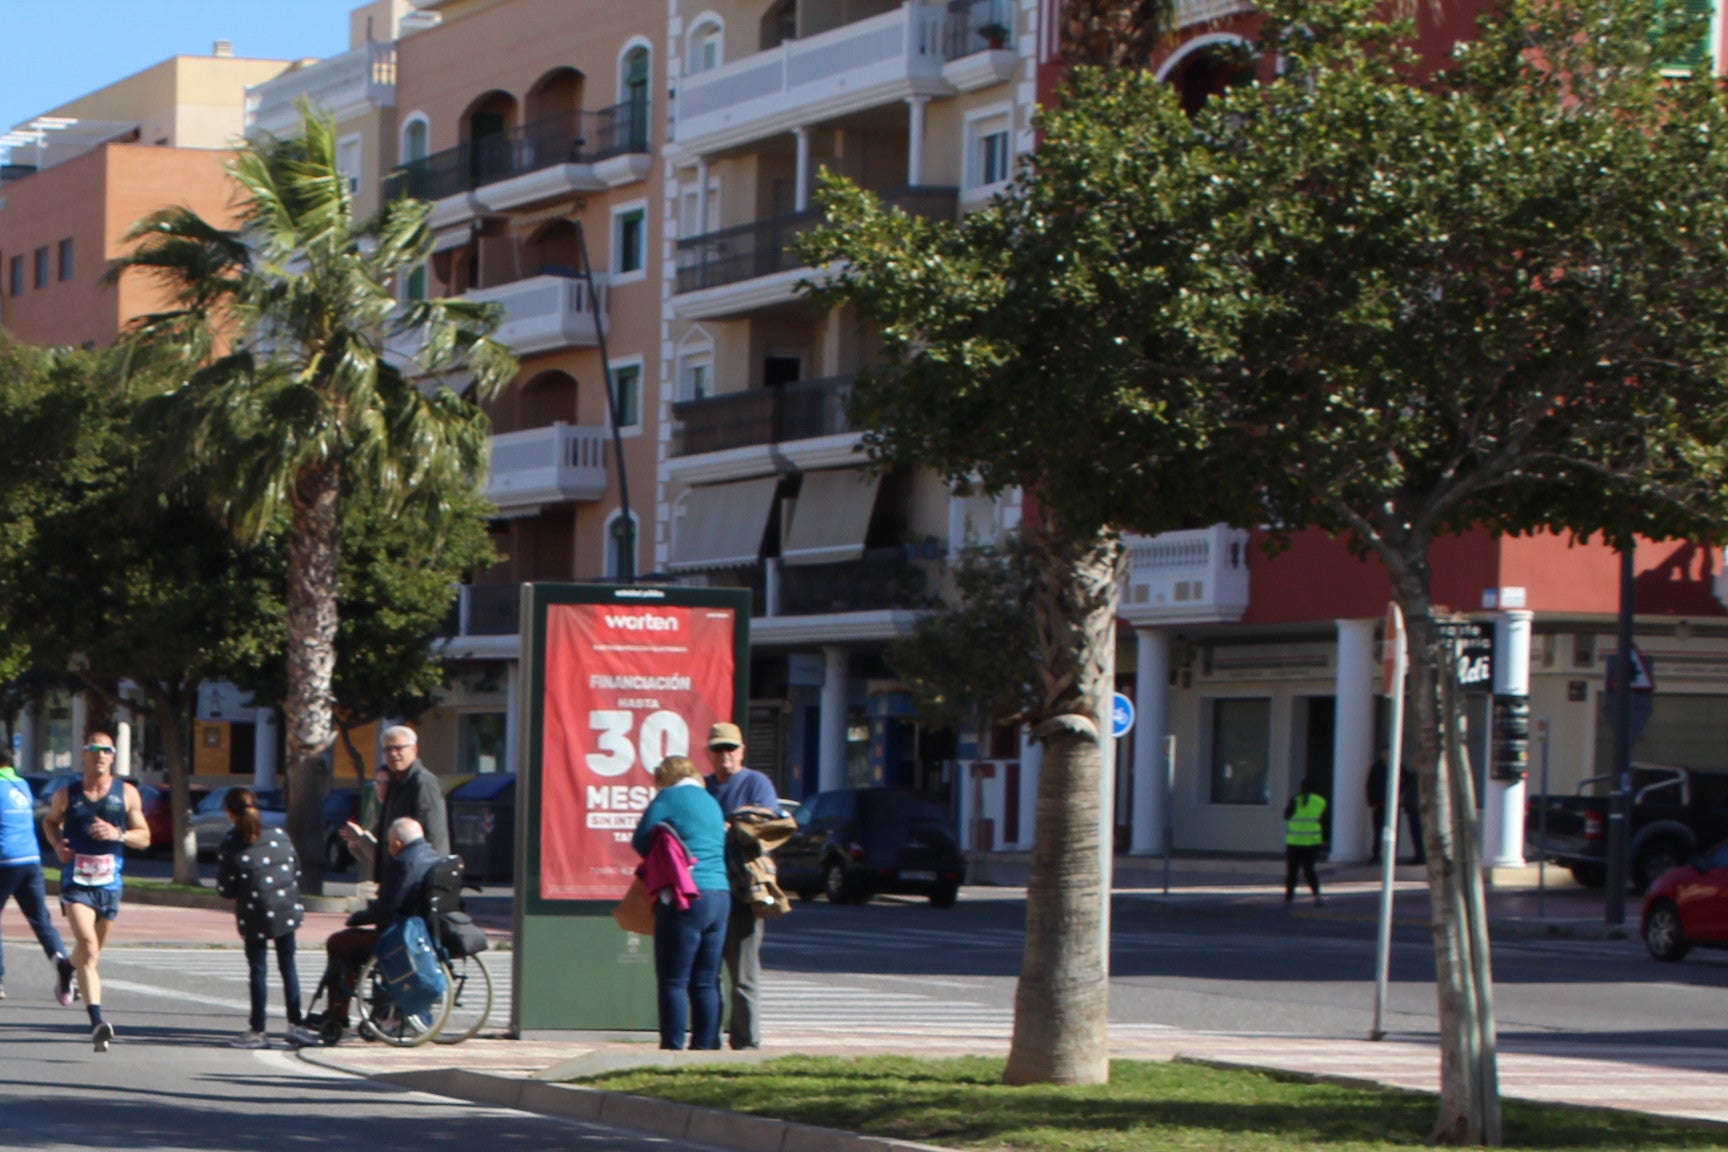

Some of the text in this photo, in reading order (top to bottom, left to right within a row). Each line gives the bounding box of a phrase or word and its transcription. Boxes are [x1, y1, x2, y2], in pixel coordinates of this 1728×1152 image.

[604, 613, 679, 631] worten
[589, 673, 691, 691] FINANCIACIÓN
[617, 698, 660, 709] HASTA
[585, 709, 690, 777] 30
[586, 784, 659, 810] MES
[591, 815, 611, 826] SIN
